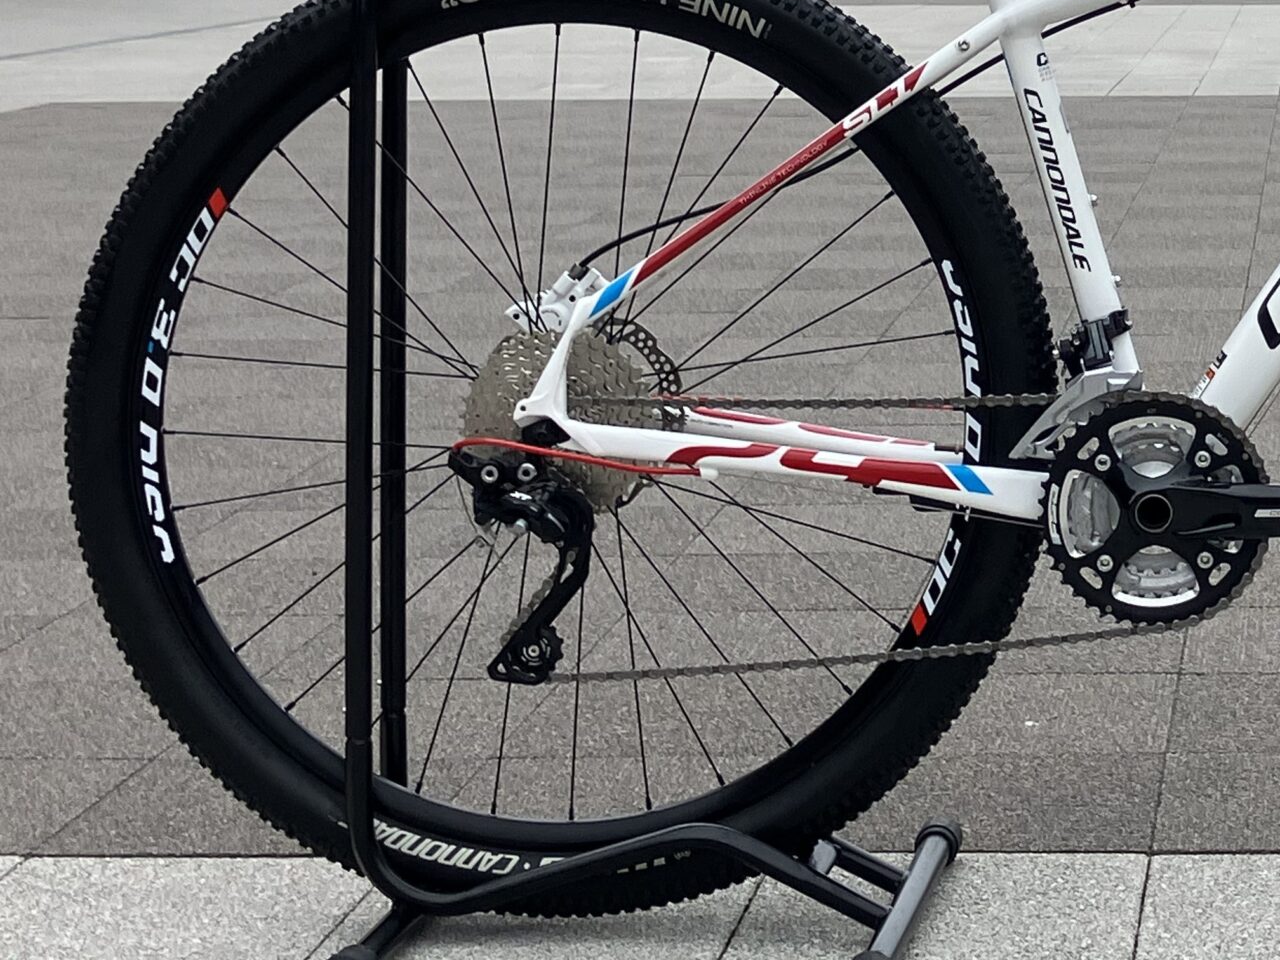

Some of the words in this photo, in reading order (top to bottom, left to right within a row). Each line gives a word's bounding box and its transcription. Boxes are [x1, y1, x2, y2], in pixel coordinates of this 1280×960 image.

[1023, 87, 1092, 273] CANNONDALE
[168, 206, 215, 293] DC
[373, 818, 520, 874] CANNONDA
